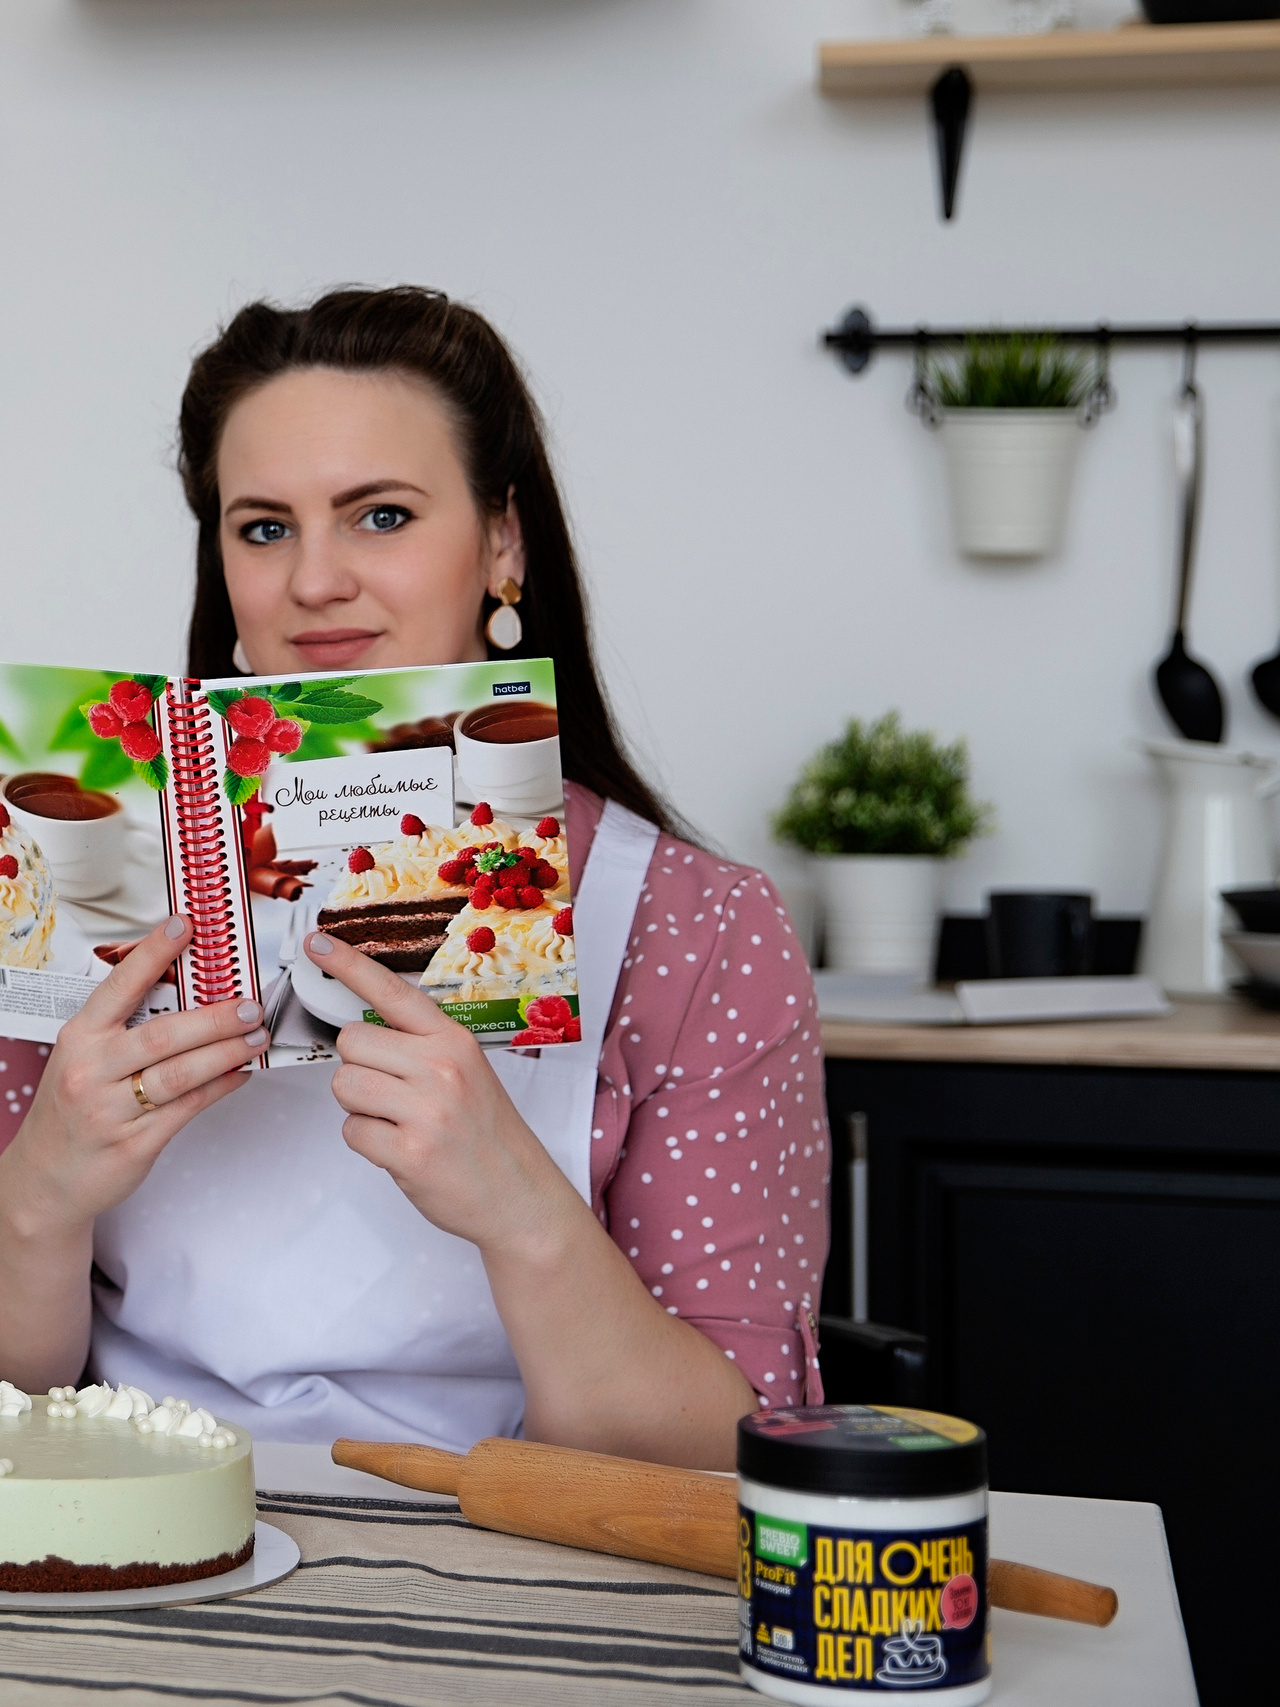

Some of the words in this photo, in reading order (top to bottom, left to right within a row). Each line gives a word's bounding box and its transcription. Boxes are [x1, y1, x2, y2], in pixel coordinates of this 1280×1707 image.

[494, 685, 528, 694] hatber
[275, 776, 328, 807] Мои
[334, 774, 438, 798] любимые
[319, 804, 400, 827] рецепты
[440, 1002, 488, 1013] инарии
[451, 1013, 472, 1022] еты
[464, 1021, 516, 1032] оржеств
[760, 1526, 799, 1546] PREBIO
[760, 1538, 799, 1557] SWEET
[814, 1537, 873, 1584] ДЛЯ
[880, 1536, 974, 1586] ОЧЕНЬ
[755, 1560, 796, 1586] ProFit
[814, 1585, 942, 1636] СЛАДКИХ
[815, 1632, 873, 1680] ДЕЛ
